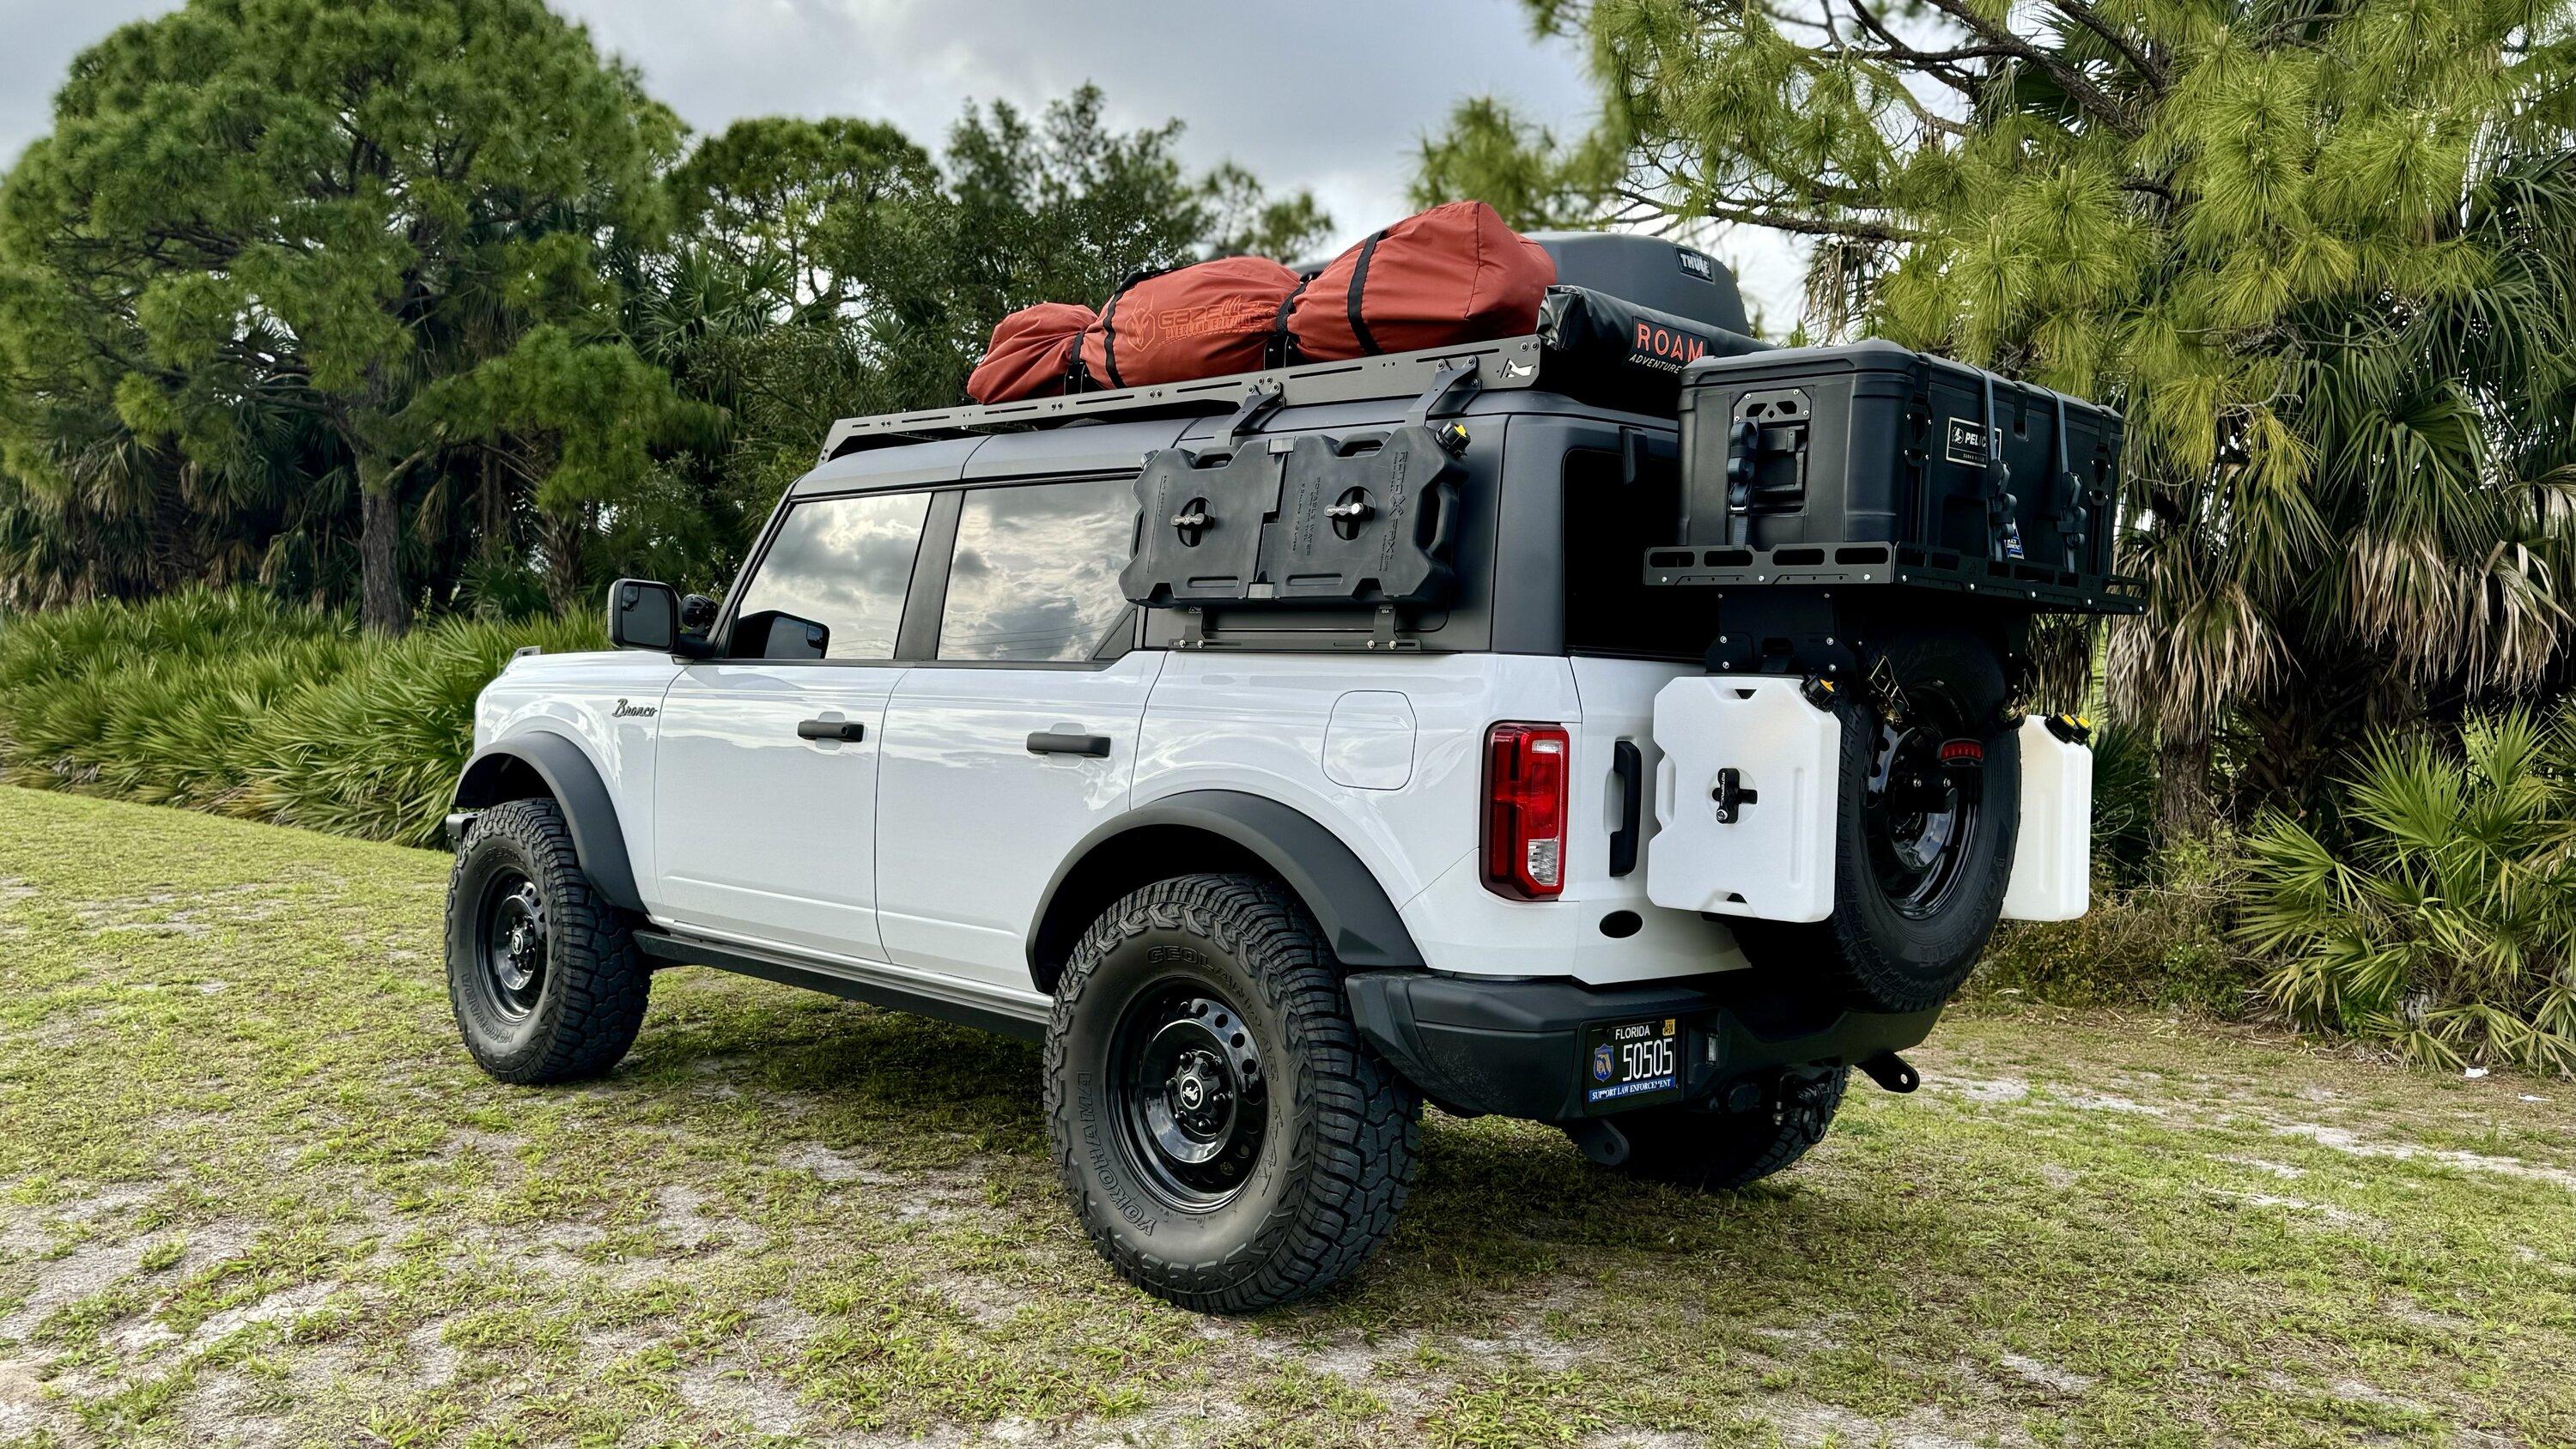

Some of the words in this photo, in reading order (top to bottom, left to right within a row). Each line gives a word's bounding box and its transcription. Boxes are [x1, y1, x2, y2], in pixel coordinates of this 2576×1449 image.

[1680, 252, 1710, 274] THULE
[1167, 320, 1209, 338] OVERLAND
[1212, 312, 1252, 330] EDITION
[1637, 323, 1704, 362] ROAM
[1629, 354, 1683, 373] ADVENTURE
[1965, 432, 1992, 448] PELIC
[611, 698, 658, 718] Bronco
[1615, 1025, 1650, 1040] FLORIDA
[1623, 1038, 1673, 1082] 50505
[1617, 1085, 1630, 1095] LAW
[1077, 1071, 1156, 1236] YOKOHAMA
